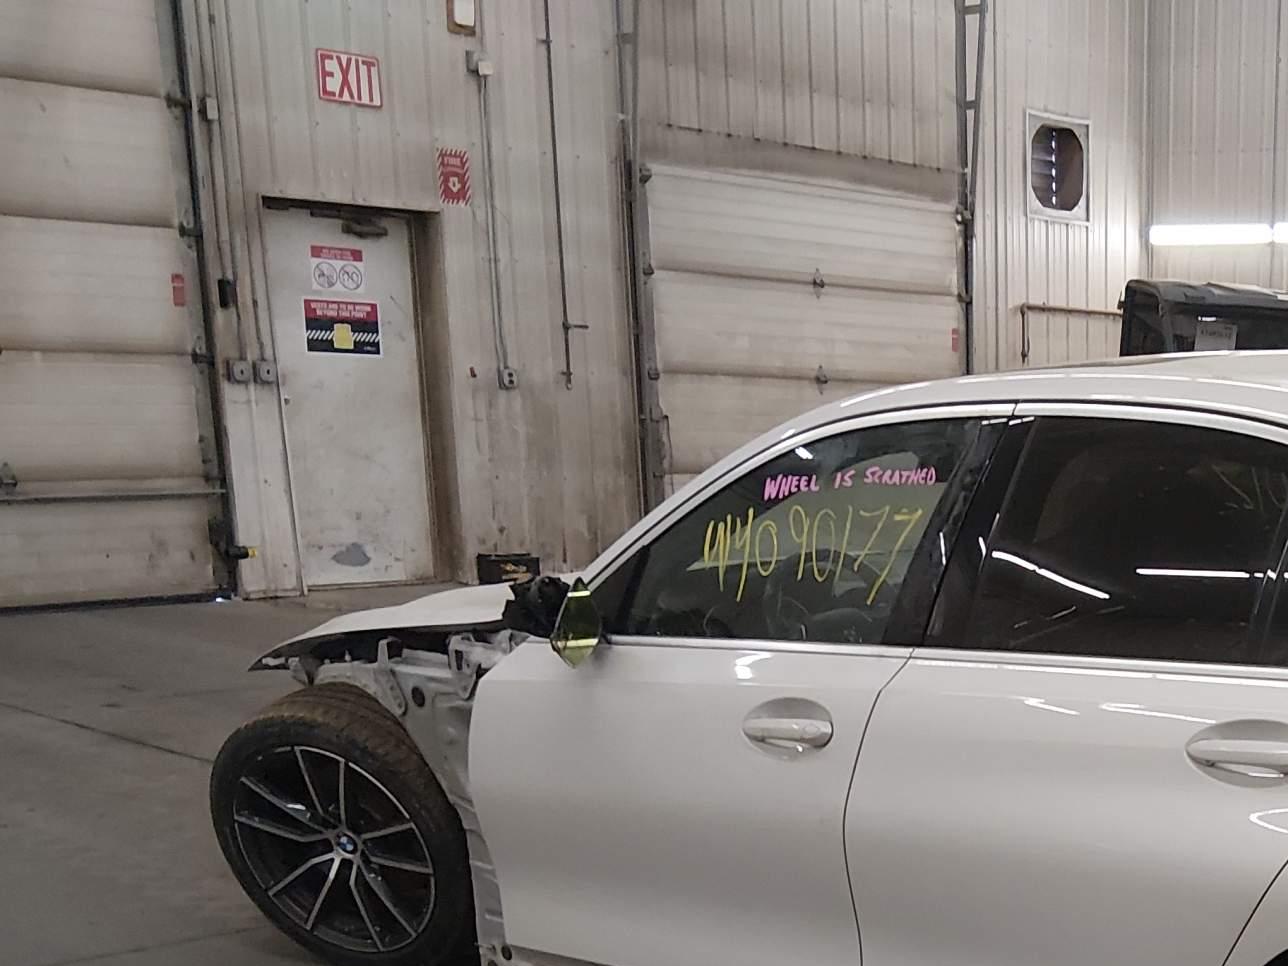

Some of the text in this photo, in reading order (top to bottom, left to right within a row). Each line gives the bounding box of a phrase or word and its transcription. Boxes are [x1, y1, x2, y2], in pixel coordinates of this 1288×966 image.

[319, 54, 376, 103] EXIT
[763, 465, 938, 502] WHEEL IS SCRATHED
[703, 504, 923, 606] 44090177
